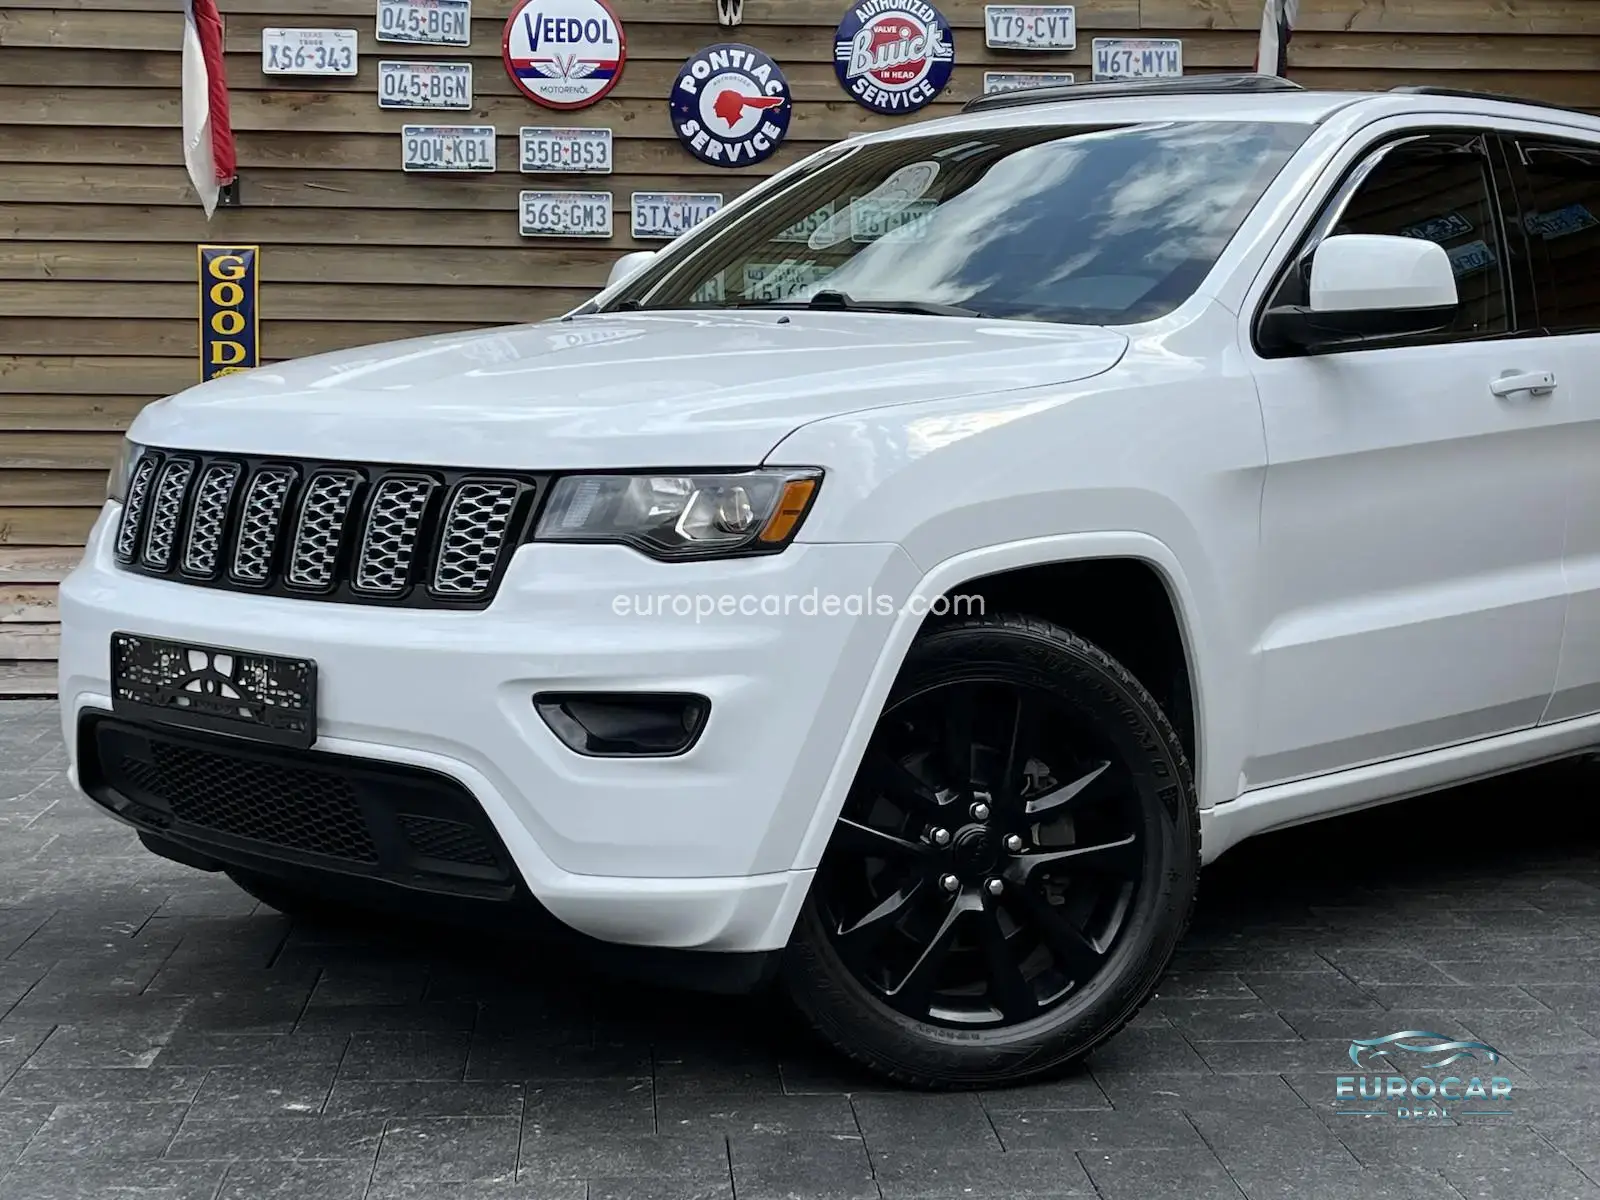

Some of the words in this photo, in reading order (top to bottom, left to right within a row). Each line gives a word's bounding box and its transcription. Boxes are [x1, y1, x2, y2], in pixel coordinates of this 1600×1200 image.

[428, 10, 465, 35] BGN
[855, 0, 935, 23] AUTHORIZED
[524, 13, 613, 52] VEEDOL
[873, 25, 897, 33] VALVE
[990, 16, 1025, 38] Y79
[1034, 17, 1070, 38] CVT
[268, 45, 305, 68] XS6
[315, 46, 351, 69] 343
[847, 21, 946, 79] Buick
[1098, 50, 1133, 73] W67
[680, 49, 783, 96] PONTIAC
[430, 75, 466, 98] BGN
[852, 78, 935, 109] SERVICE
[525, 140, 561, 163] 55B
[571, 141, 607, 164] BS3
[680, 120, 781, 162] SERVICE
[526, 203, 561, 226] 56S
[570, 204, 606, 227] GM3
[637, 205, 672, 228] 5TX
[208, 254, 246, 365] GOOD
